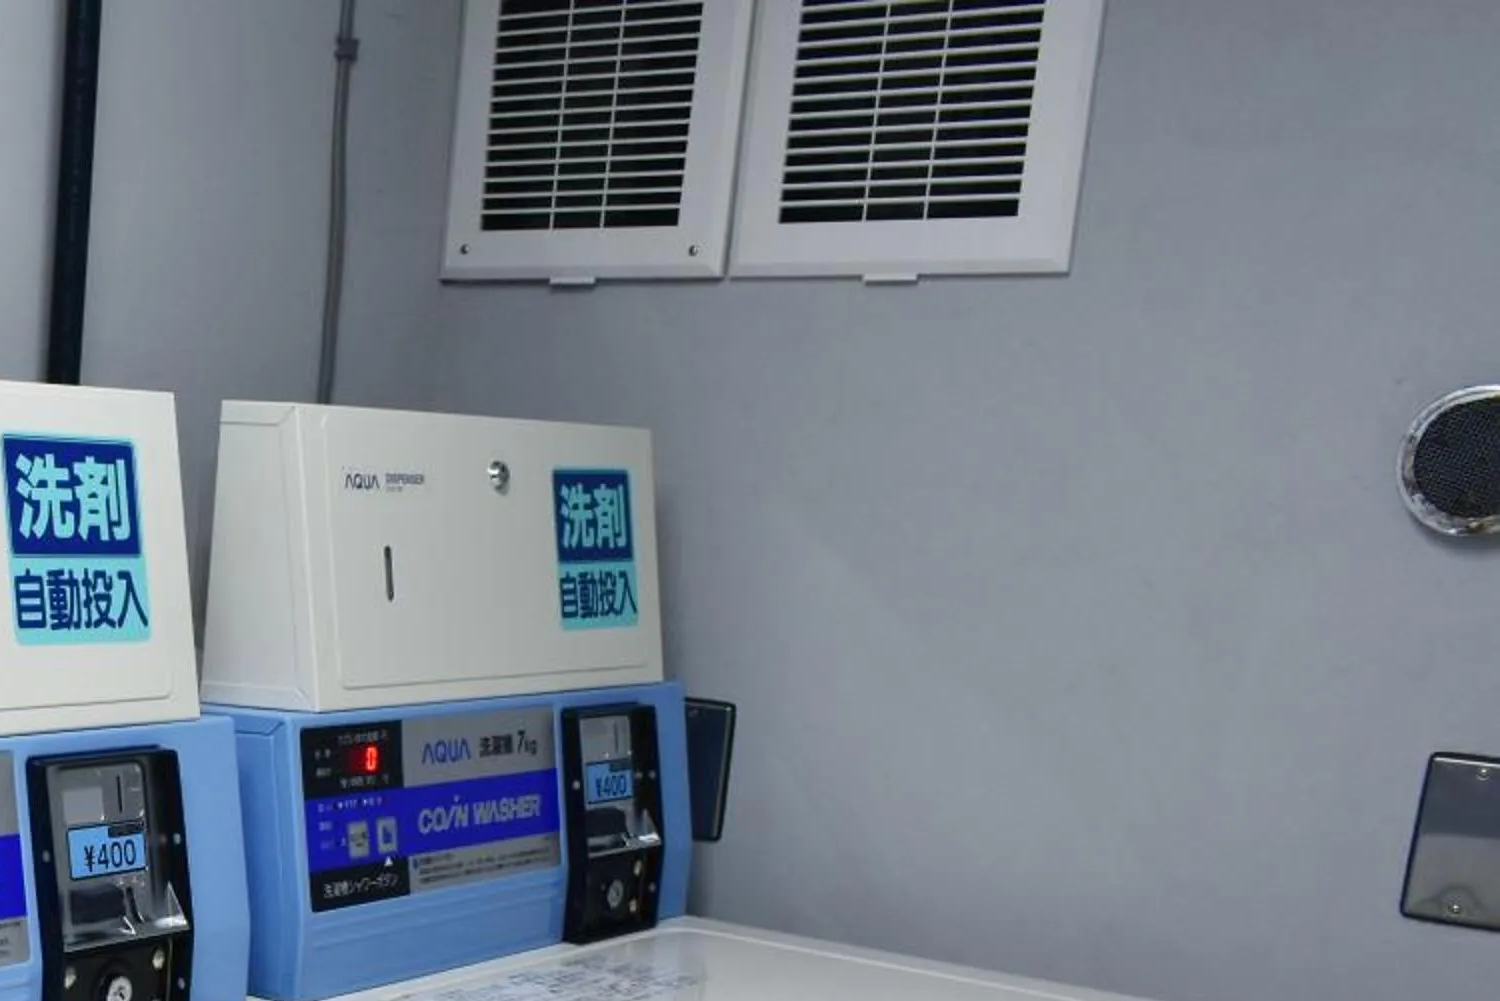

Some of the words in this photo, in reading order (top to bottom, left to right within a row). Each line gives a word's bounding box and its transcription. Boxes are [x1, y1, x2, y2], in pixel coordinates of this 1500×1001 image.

[14, 451, 132, 542] 洗剤
[345, 473, 380, 490] AQUA
[560, 483, 628, 549] 洗剤
[14, 567, 149, 632] 自動投入
[560, 570, 637, 620] 自動投入
[366, 746, 379, 771] 0
[421, 737, 471, 765] AQUA
[472, 793, 542, 825] WASHER
[83, 838, 138, 873] ¥400
